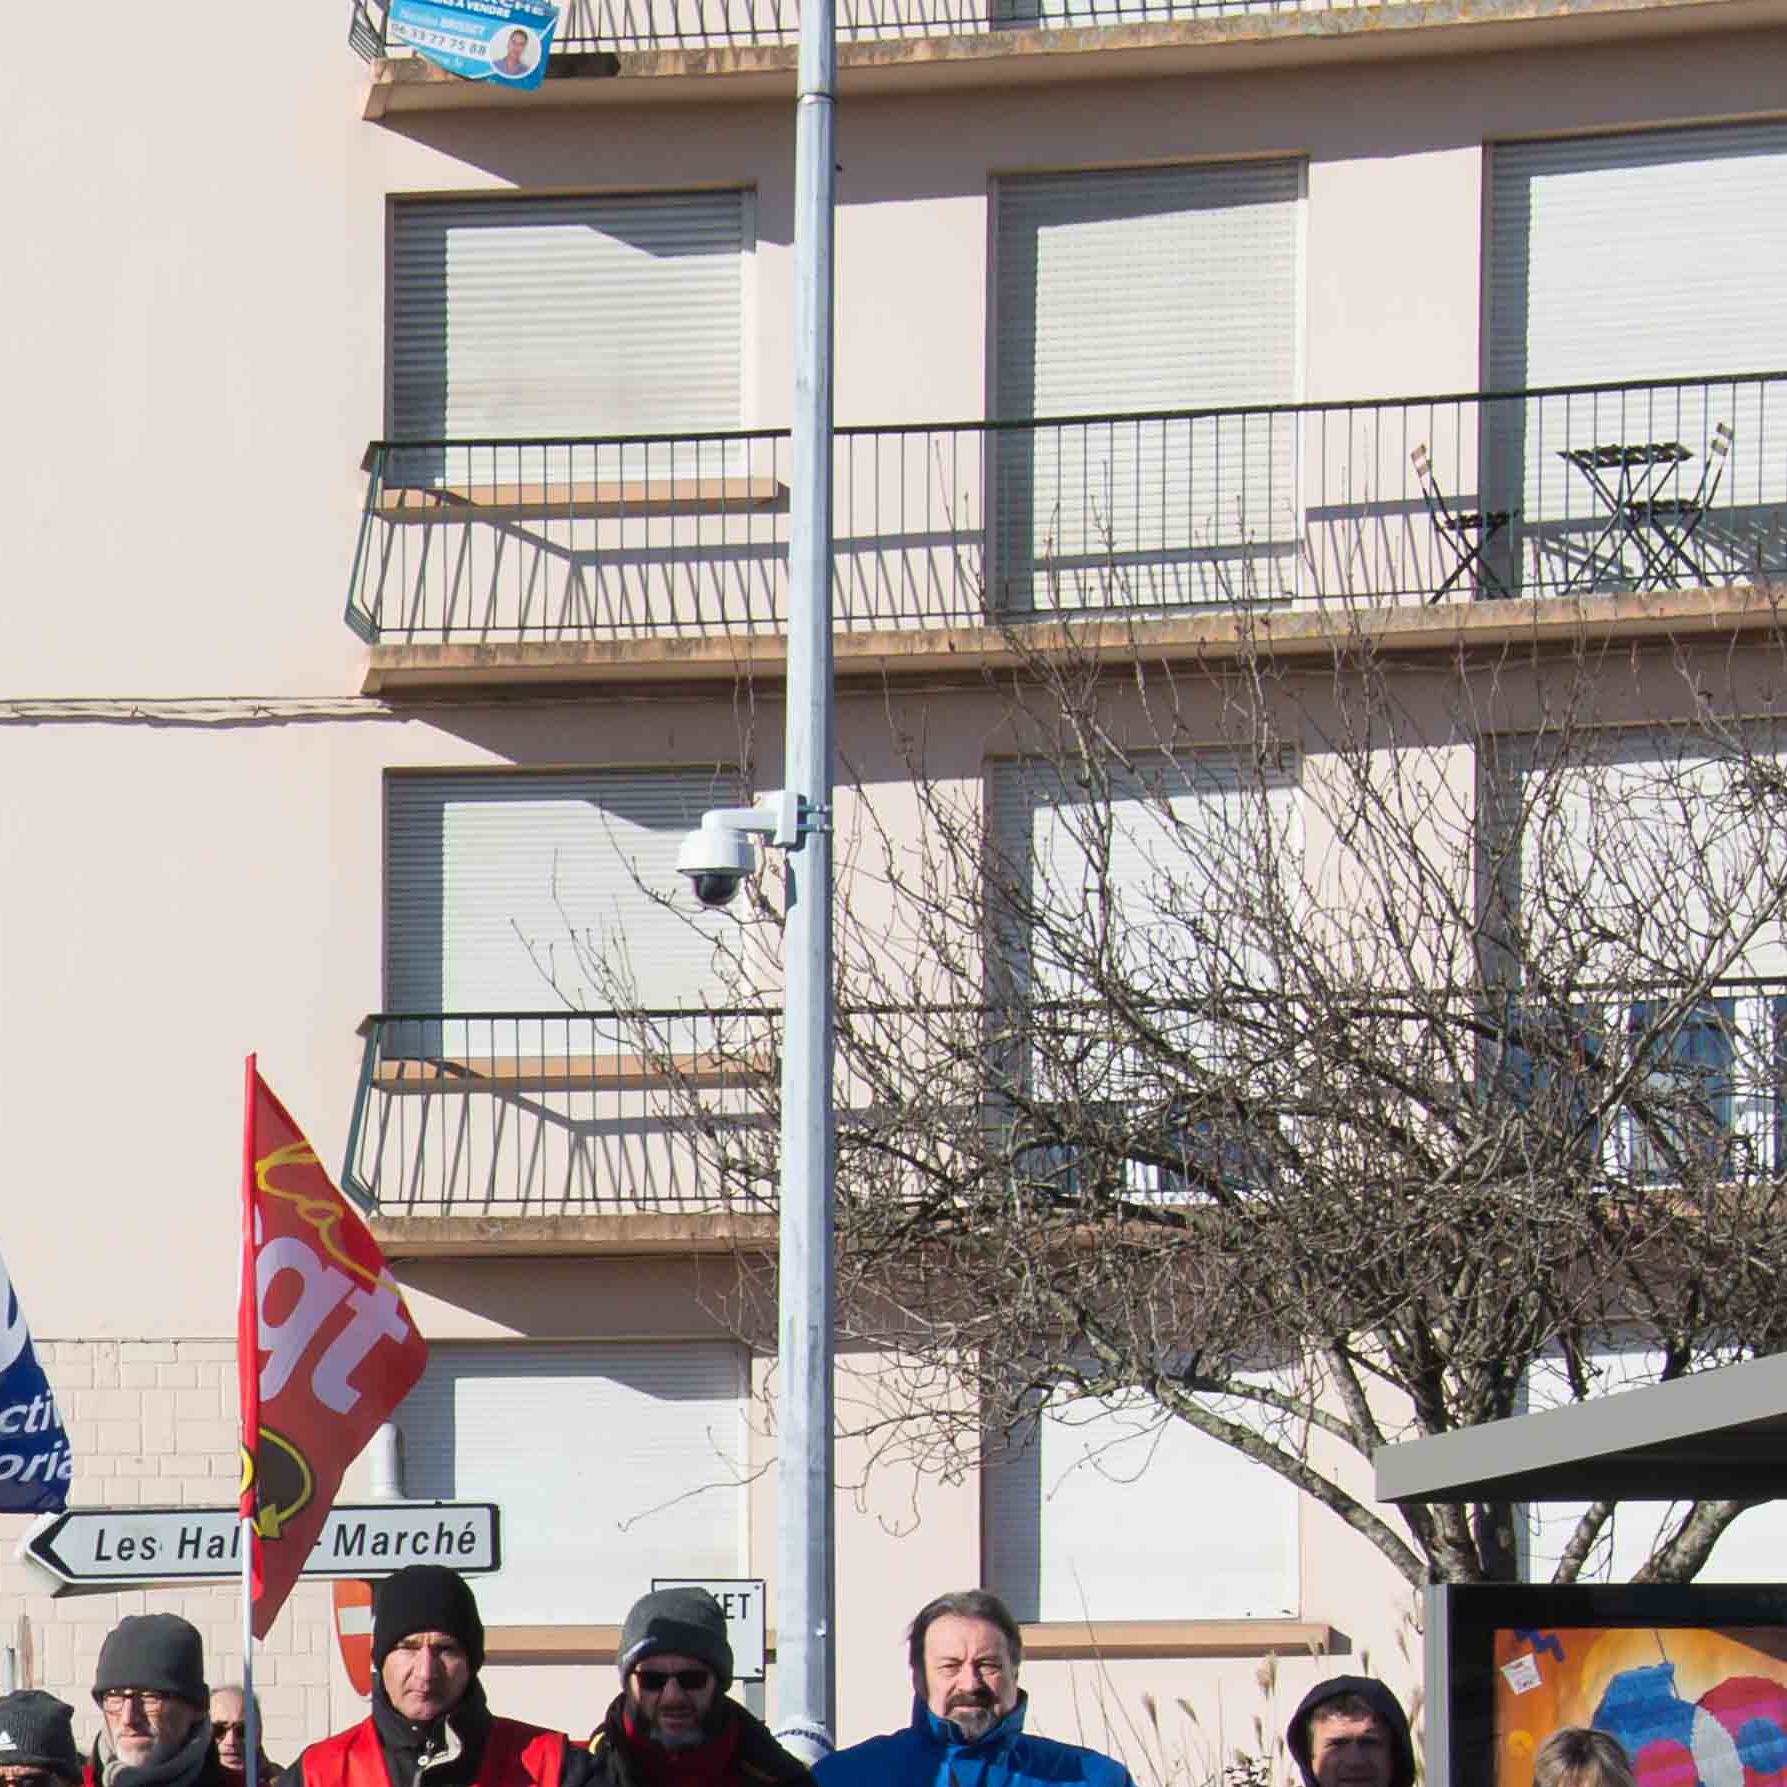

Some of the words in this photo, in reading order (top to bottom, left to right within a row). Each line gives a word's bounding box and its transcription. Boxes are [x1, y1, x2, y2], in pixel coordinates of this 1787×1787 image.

[94, 1528, 156, 1561] Les
[177, 1526, 241, 1559] Hal
[332, 1521, 477, 1558] Marché
